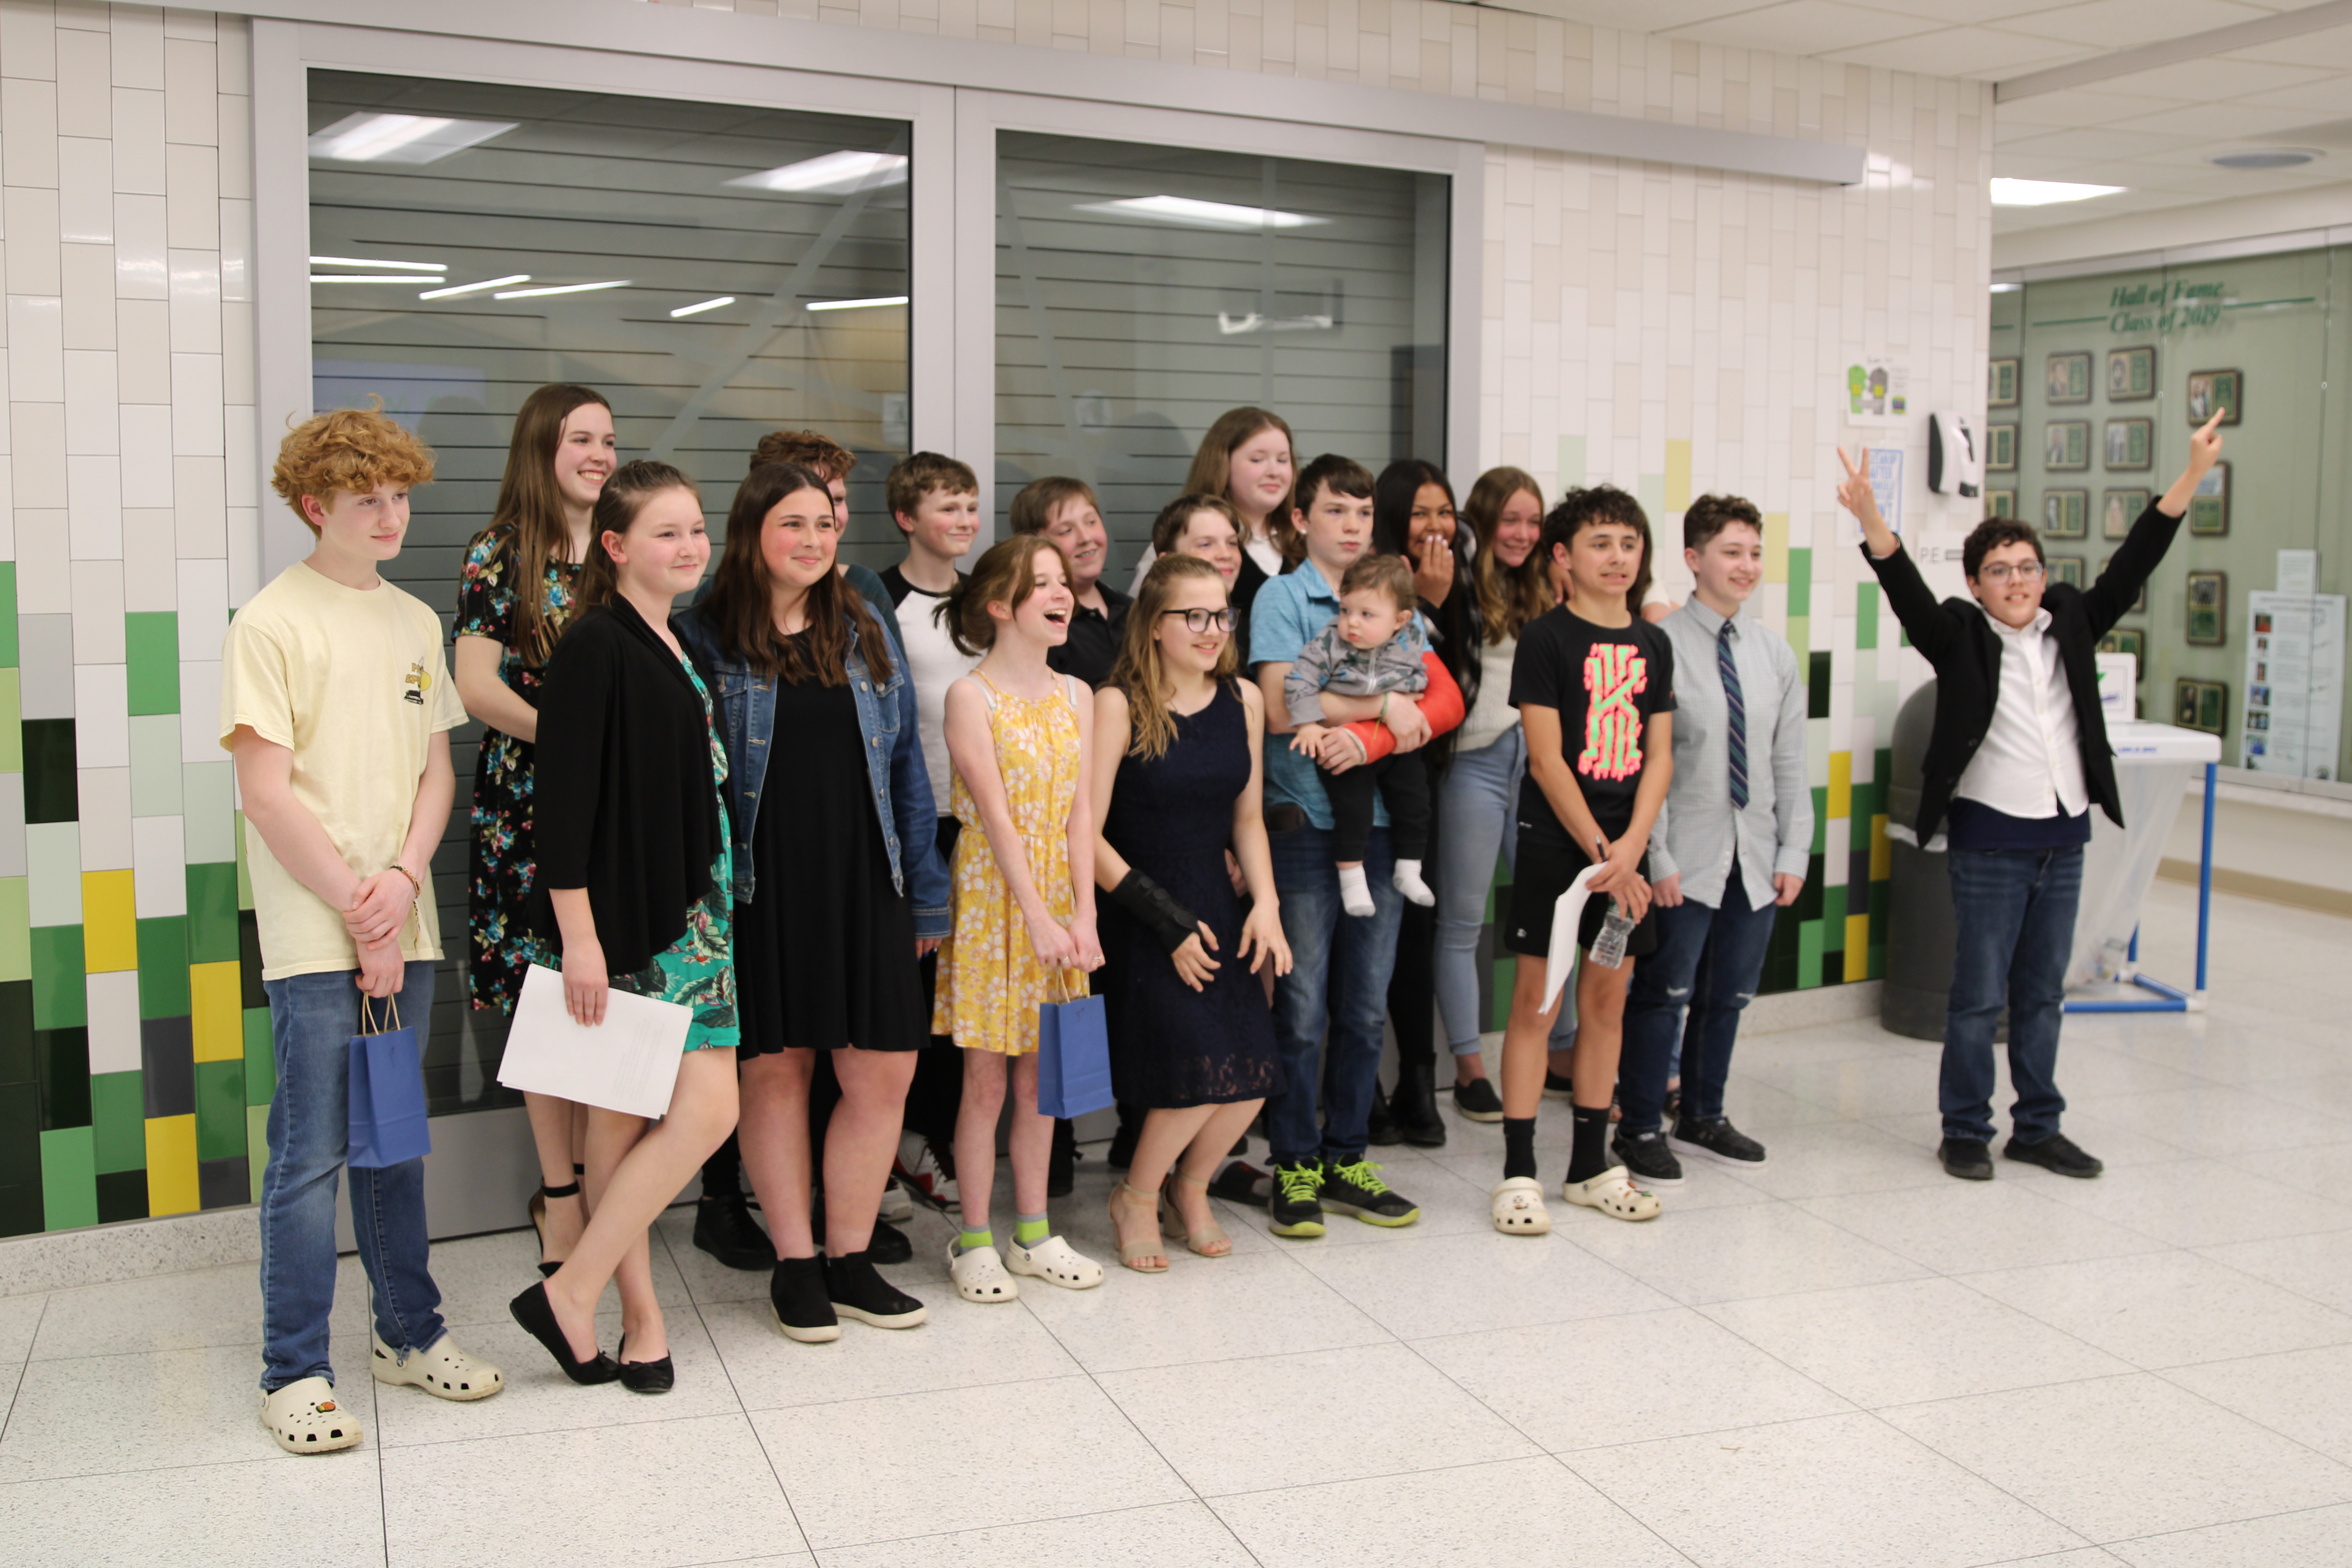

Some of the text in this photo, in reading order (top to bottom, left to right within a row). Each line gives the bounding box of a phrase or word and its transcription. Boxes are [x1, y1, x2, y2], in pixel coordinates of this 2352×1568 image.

[2110, 279, 2224, 308] Hall of Fame
